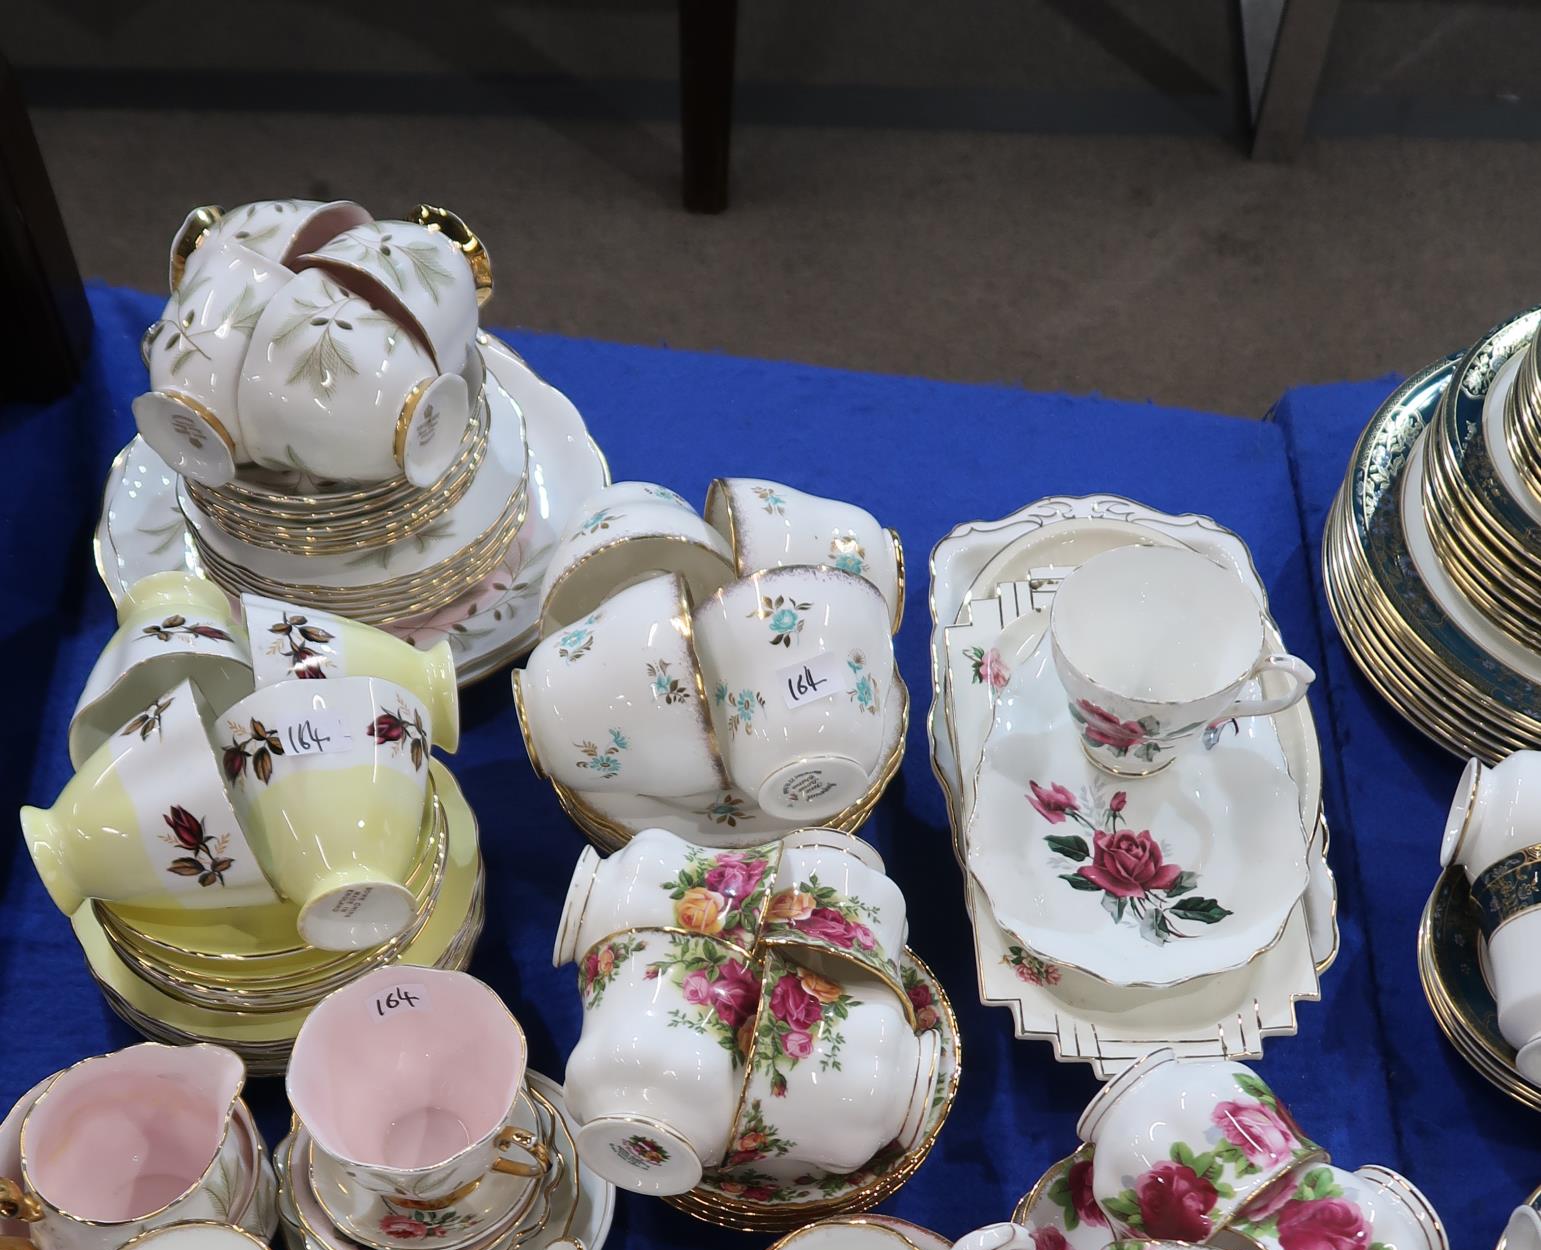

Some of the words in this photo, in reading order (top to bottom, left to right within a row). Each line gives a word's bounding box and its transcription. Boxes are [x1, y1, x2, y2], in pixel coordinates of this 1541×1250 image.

[787, 665, 828, 701] 164
[288, 719, 331, 754] 164
[376, 987, 420, 1016] 164
